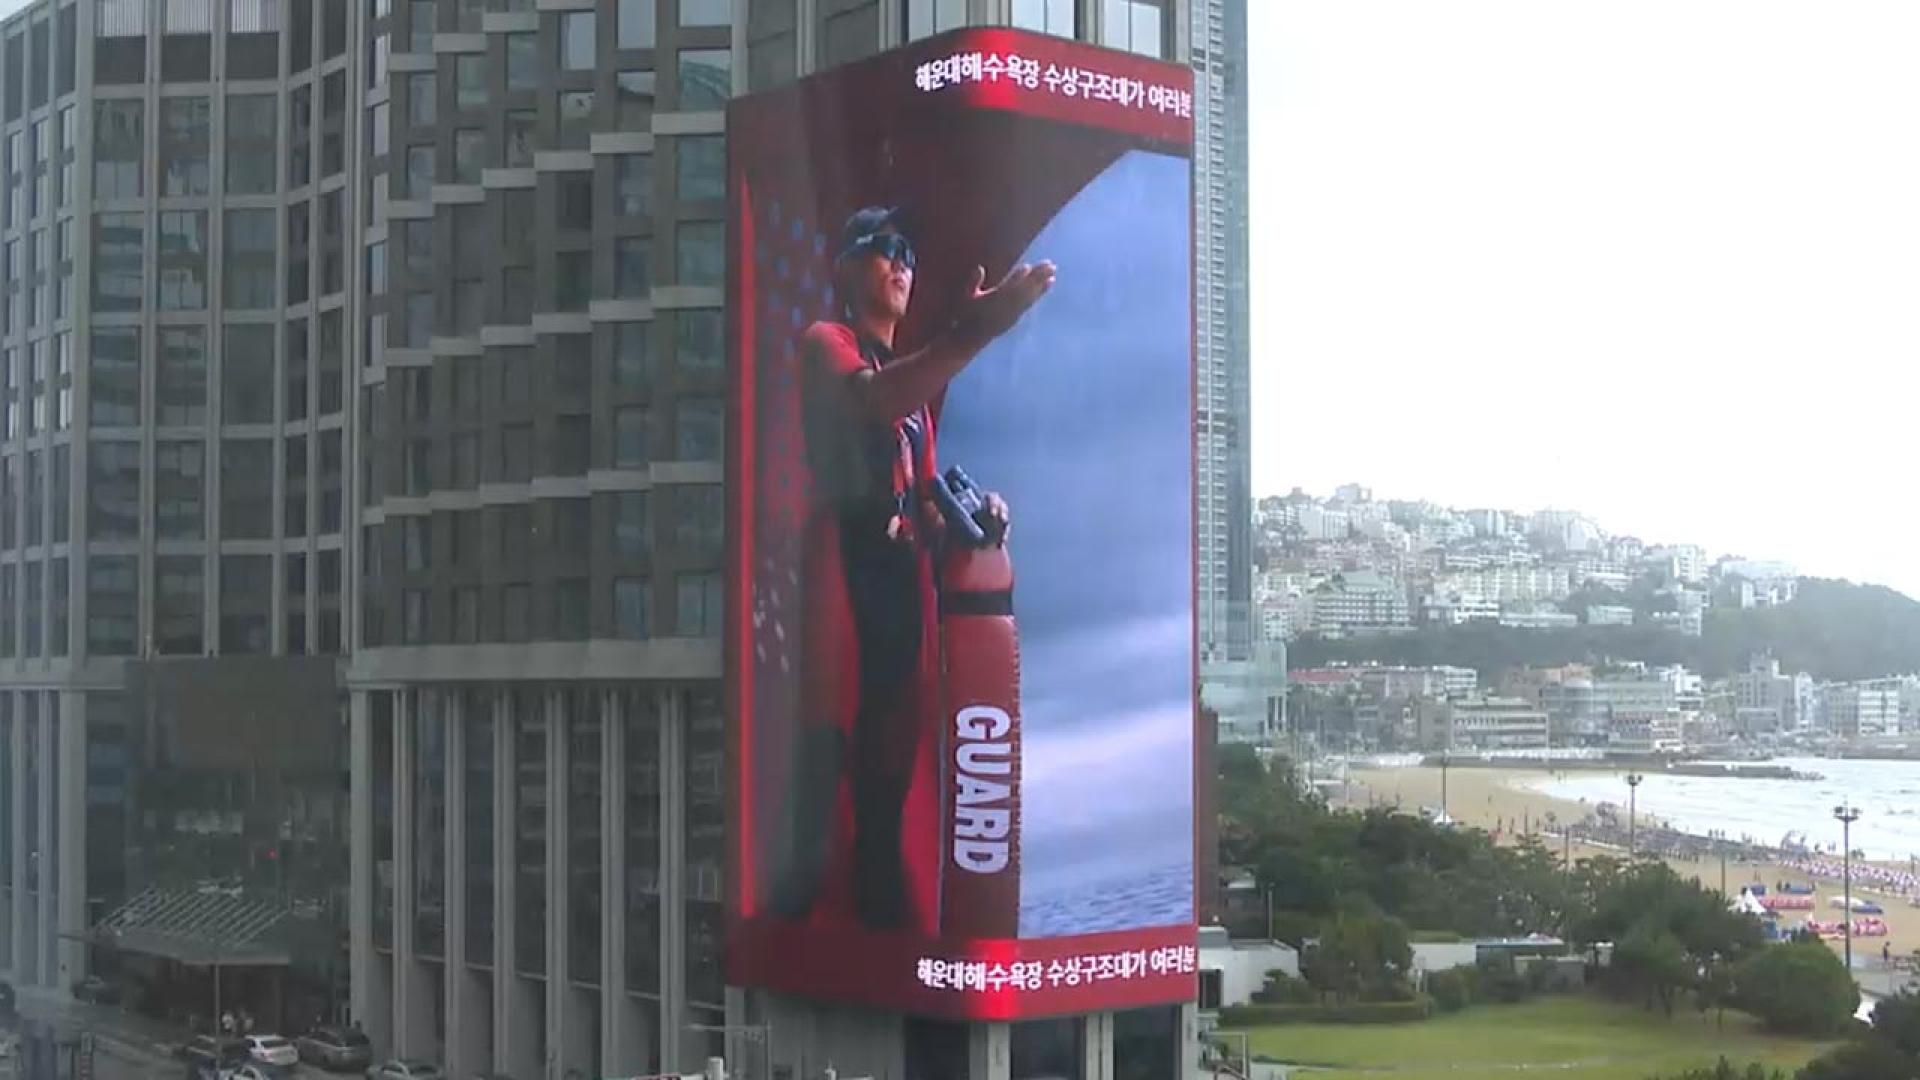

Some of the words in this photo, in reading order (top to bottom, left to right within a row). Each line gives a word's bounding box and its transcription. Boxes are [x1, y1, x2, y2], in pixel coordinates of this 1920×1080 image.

[915, 54, 1041, 90] 해운대해수욕장
[1044, 65, 1146, 108] 수상구조대가
[953, 706, 1011, 874] GUARD
[917, 957, 1043, 991] 해운대해수욕장
[1047, 953, 1148, 985] 수상구조대가
